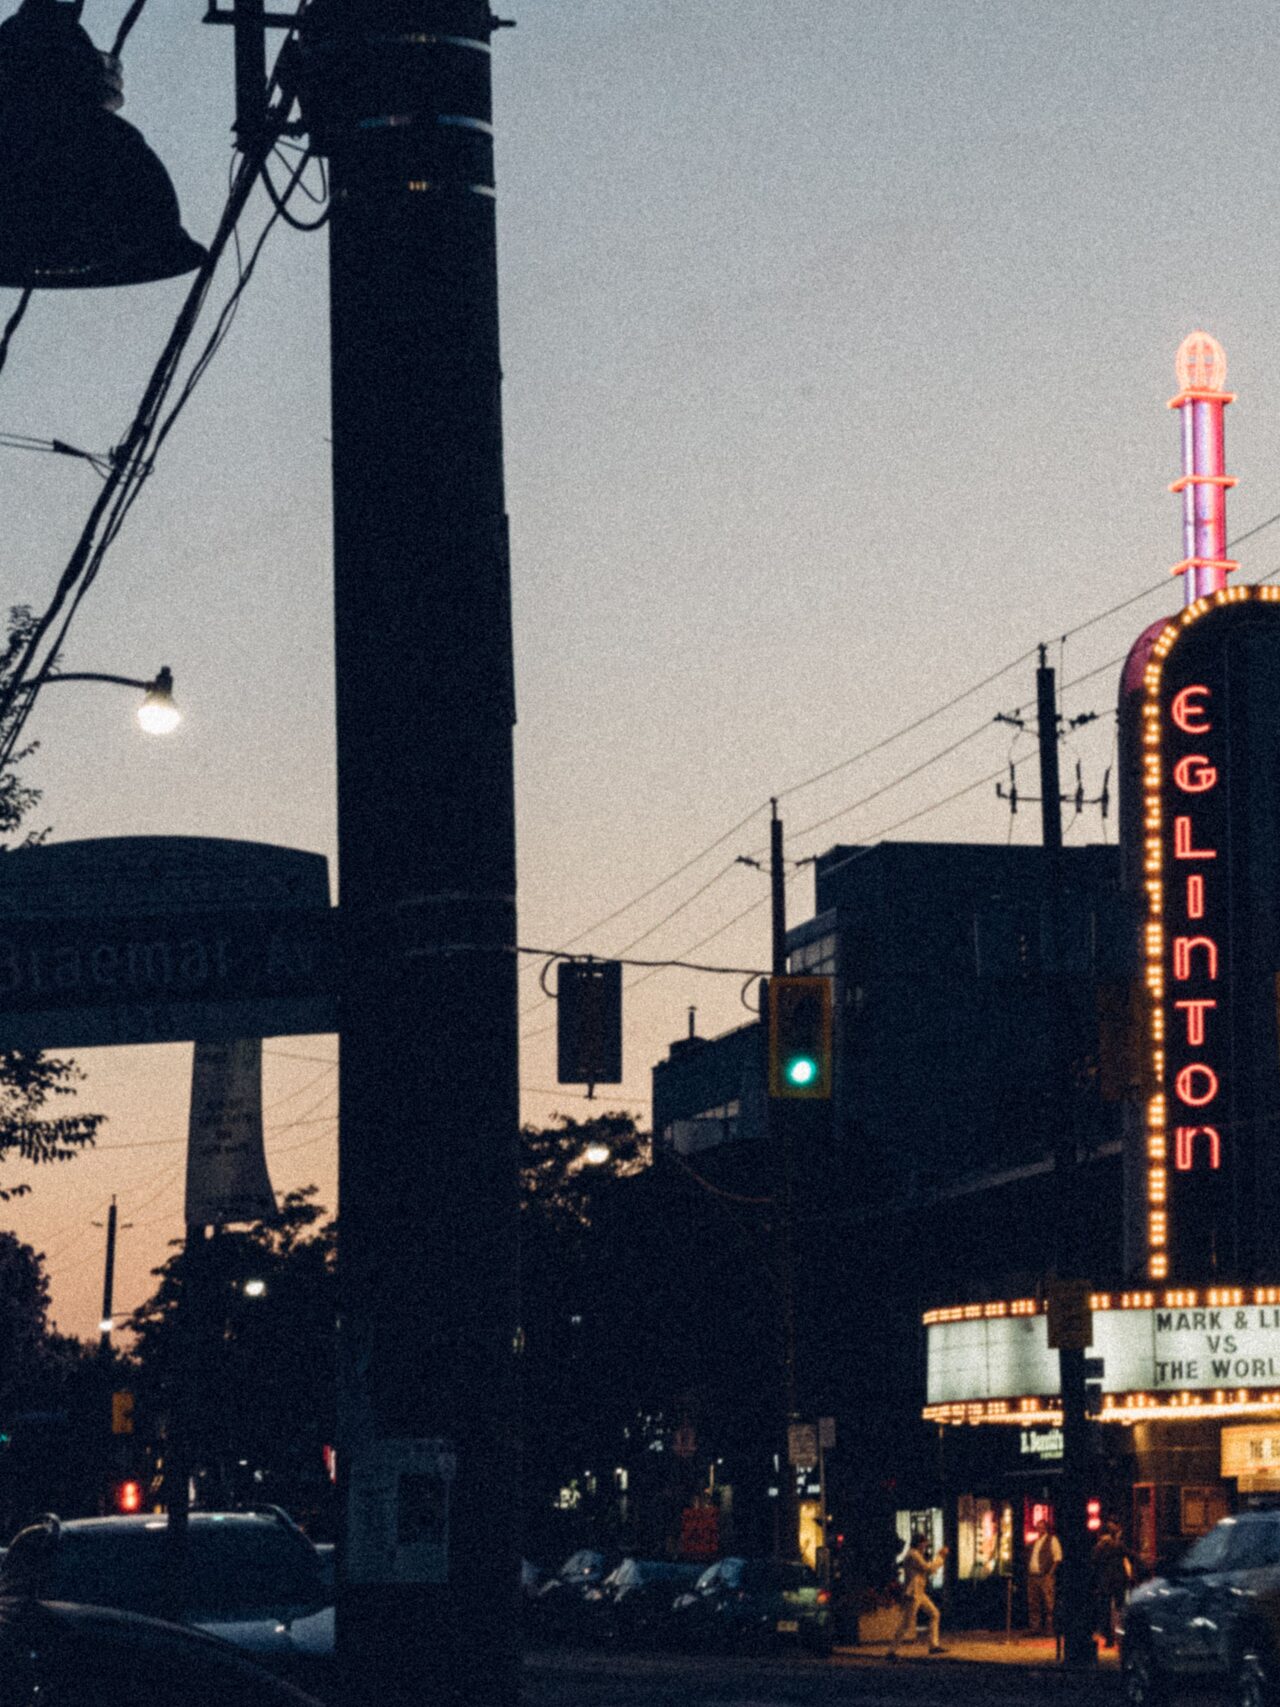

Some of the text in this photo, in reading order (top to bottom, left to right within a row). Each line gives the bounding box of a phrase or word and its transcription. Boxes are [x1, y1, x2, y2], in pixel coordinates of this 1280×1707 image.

[1172, 685, 1220, 1170] EGLINTON
[1157, 1310, 1222, 1331] MARK
[1234, 1310, 1248, 1330] &
[1206, 1334, 1238, 1354] VS
[1155, 1360, 1199, 1382] THE
